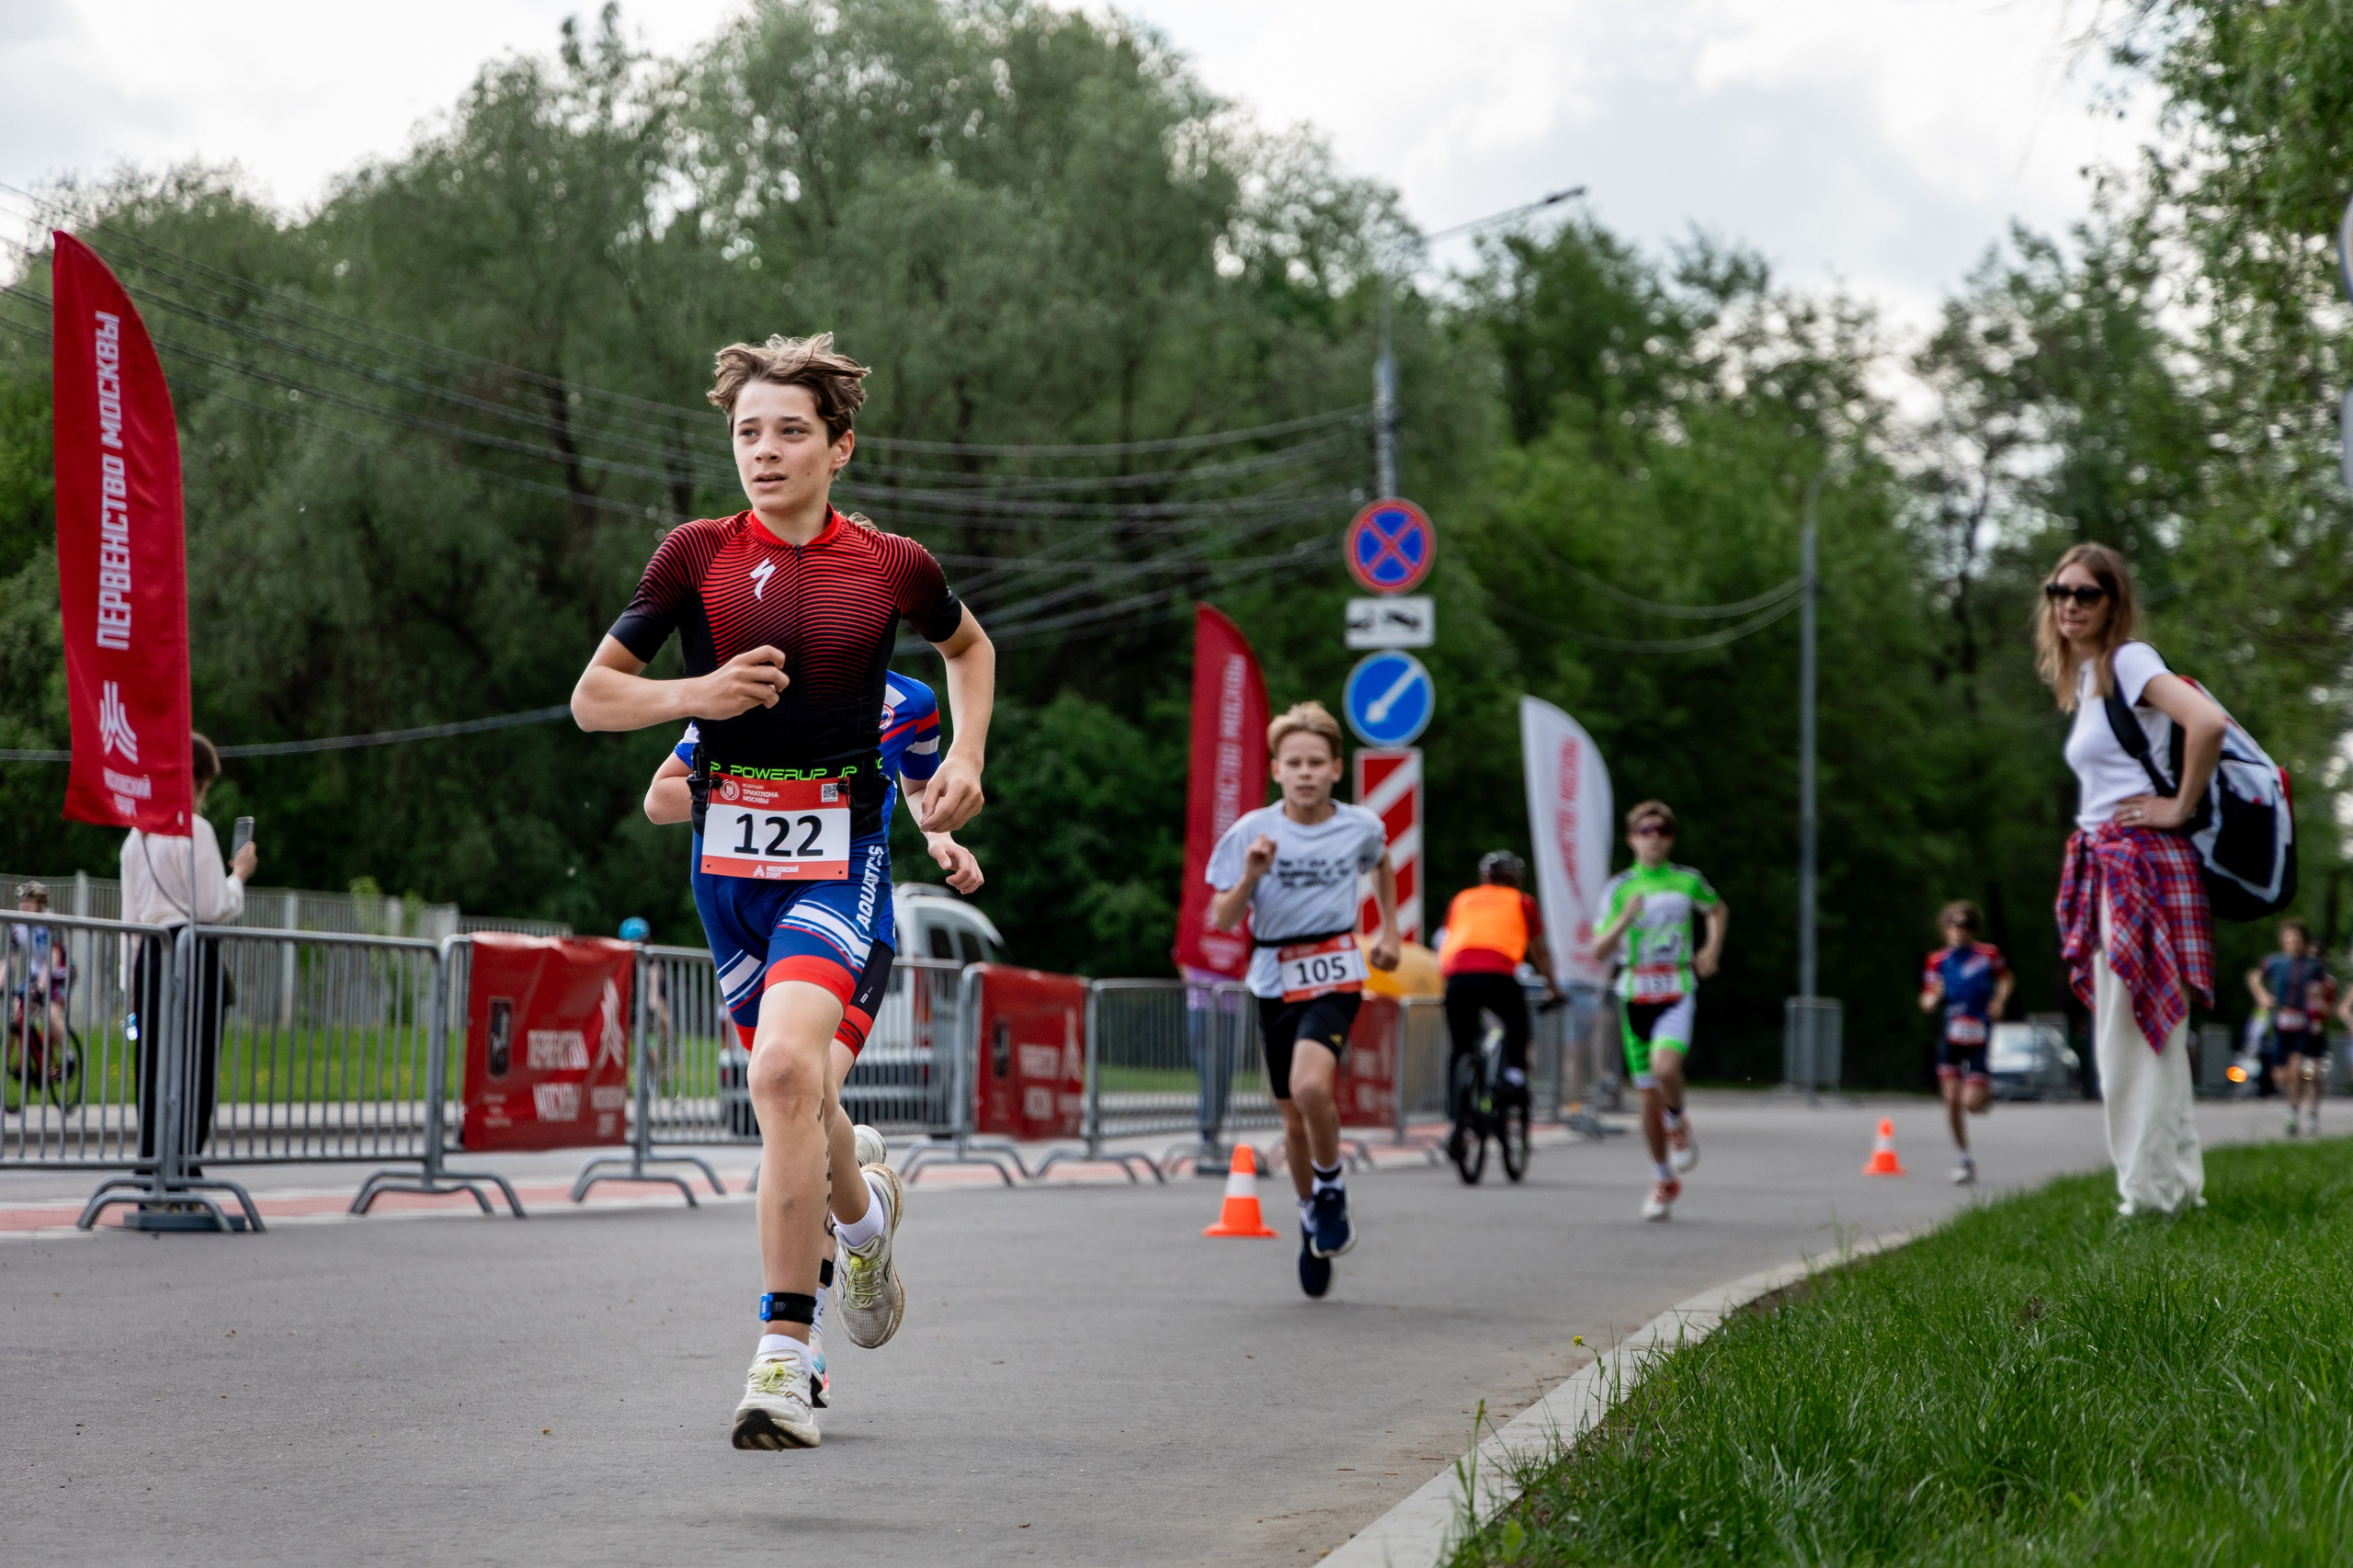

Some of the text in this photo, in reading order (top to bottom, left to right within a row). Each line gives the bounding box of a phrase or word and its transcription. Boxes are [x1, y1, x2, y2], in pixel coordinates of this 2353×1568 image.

[95, 310, 131, 651] ПЕРВЕНСТВО МОСКВЫ
[730, 765, 827, 780] POWERUP
[743, 789, 779, 798] ТРИАТЛОНА
[743, 795, 769, 804] МОСКВЫ
[733, 813, 824, 857] 122
[1295, 956, 1347, 985] 105
